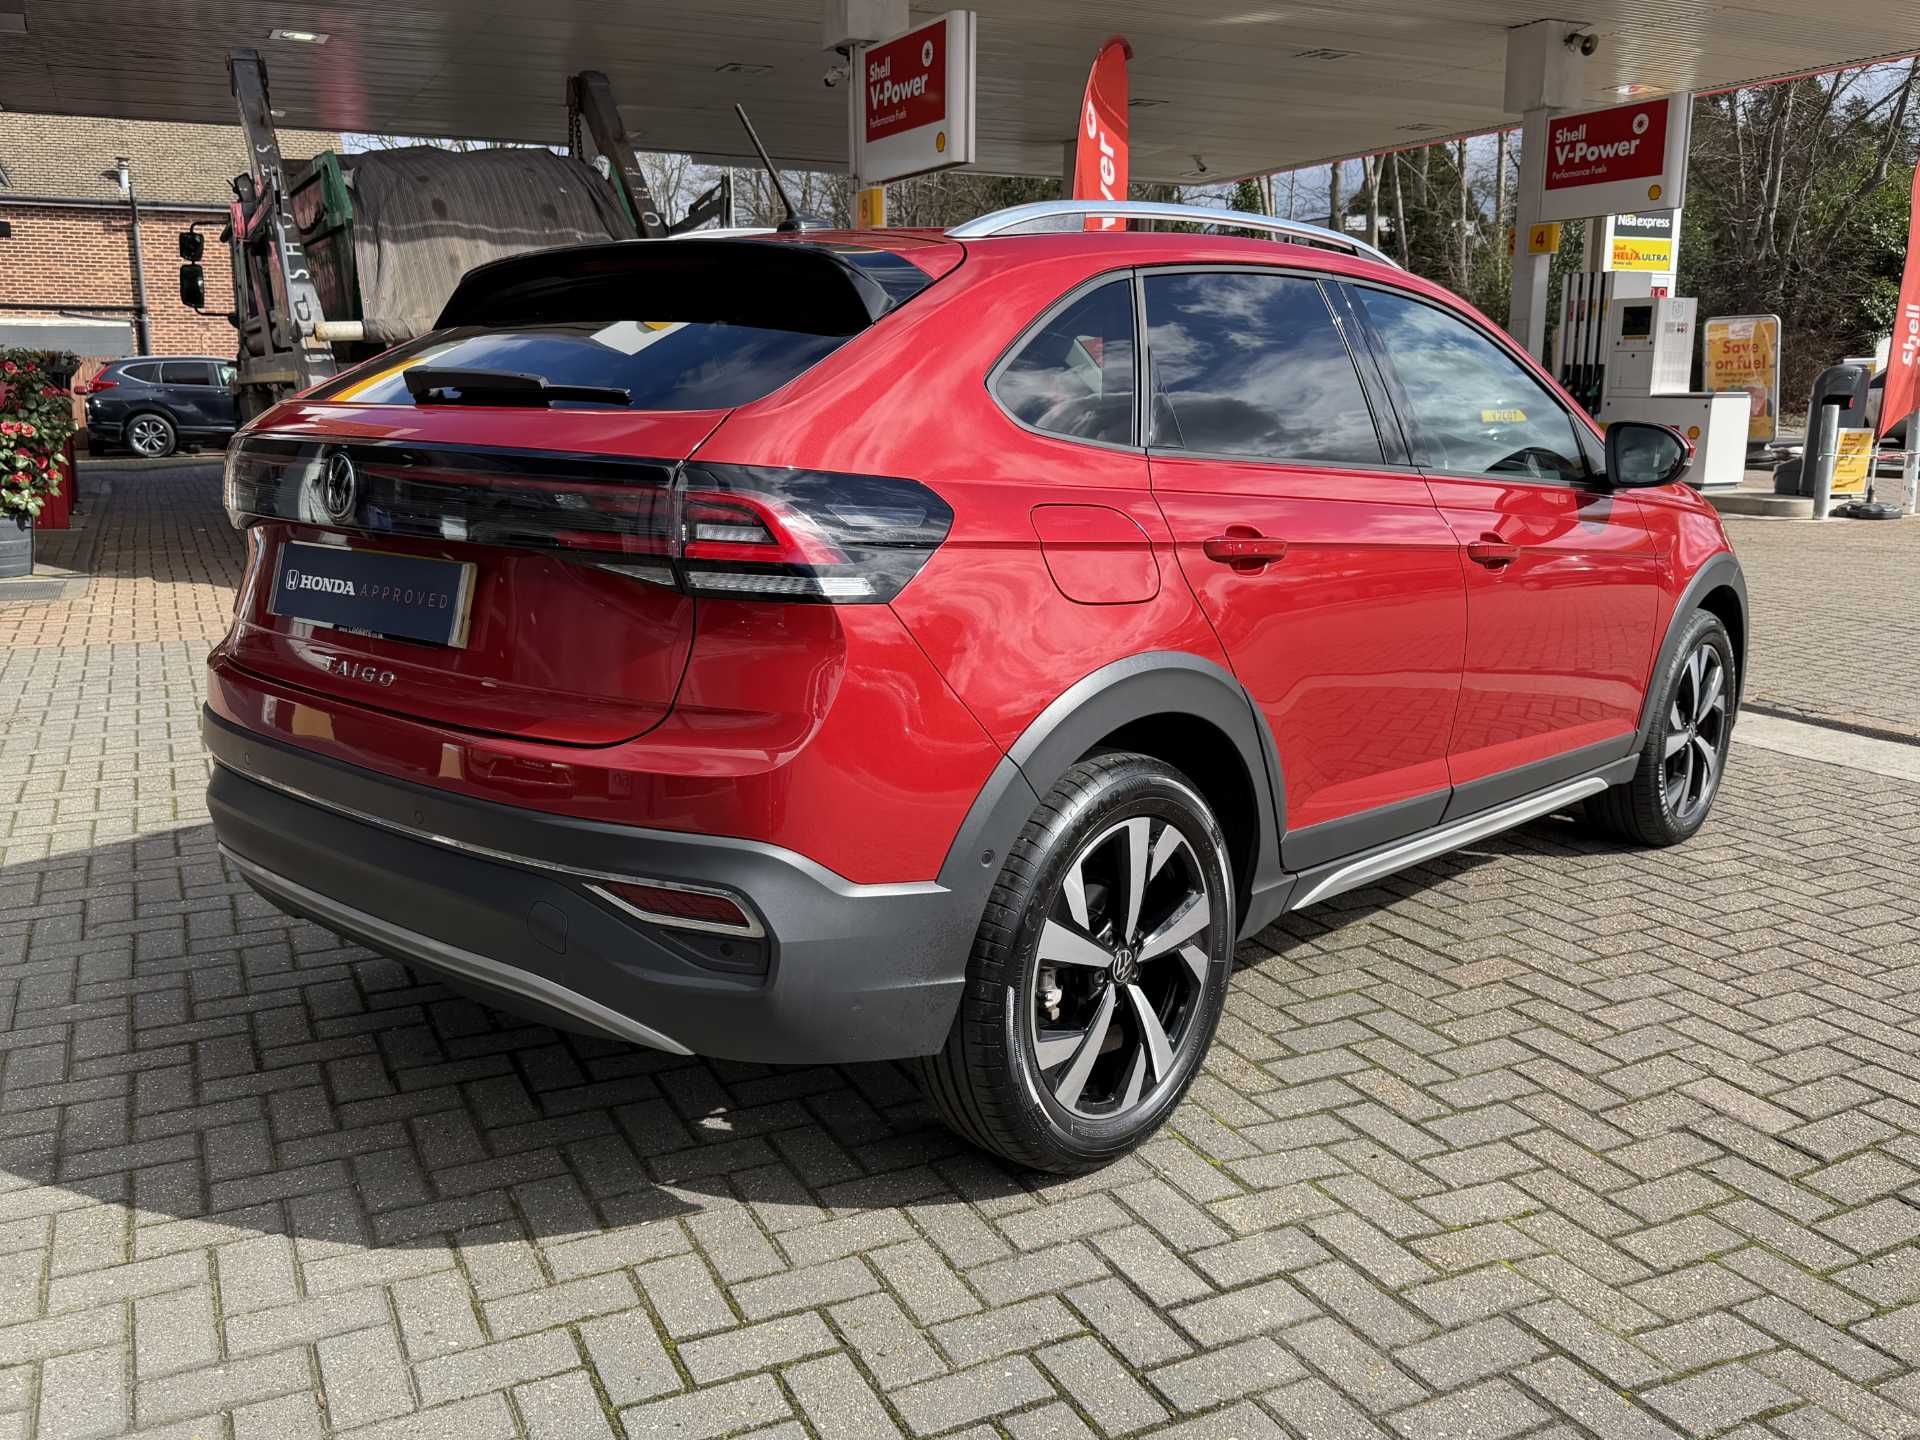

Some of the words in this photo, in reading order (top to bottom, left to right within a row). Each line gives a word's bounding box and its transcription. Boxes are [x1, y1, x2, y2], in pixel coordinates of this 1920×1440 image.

[870, 56, 891, 82] Shell
[870, 73, 928, 110] V-Power
[1555, 123, 1587, 144] Shell
[1555, 138, 1640, 166] V-Power
[1552, 169, 1590, 181] Performance
[1591, 164, 1607, 174] Fuels
[1637, 217, 1670, 229] express
[1535, 231, 1544, 247] 4
[1613, 248, 1641, 261] HELIX
[1641, 253, 1668, 262] ULTRA
[1722, 340, 1759, 354] Save
[1715, 360, 1733, 370] on
[1737, 354, 1766, 369] fuel
[299, 574, 356, 596] HONDA
[360, 583, 448, 609] APPROVED
[325, 656, 397, 687] TAIGO
